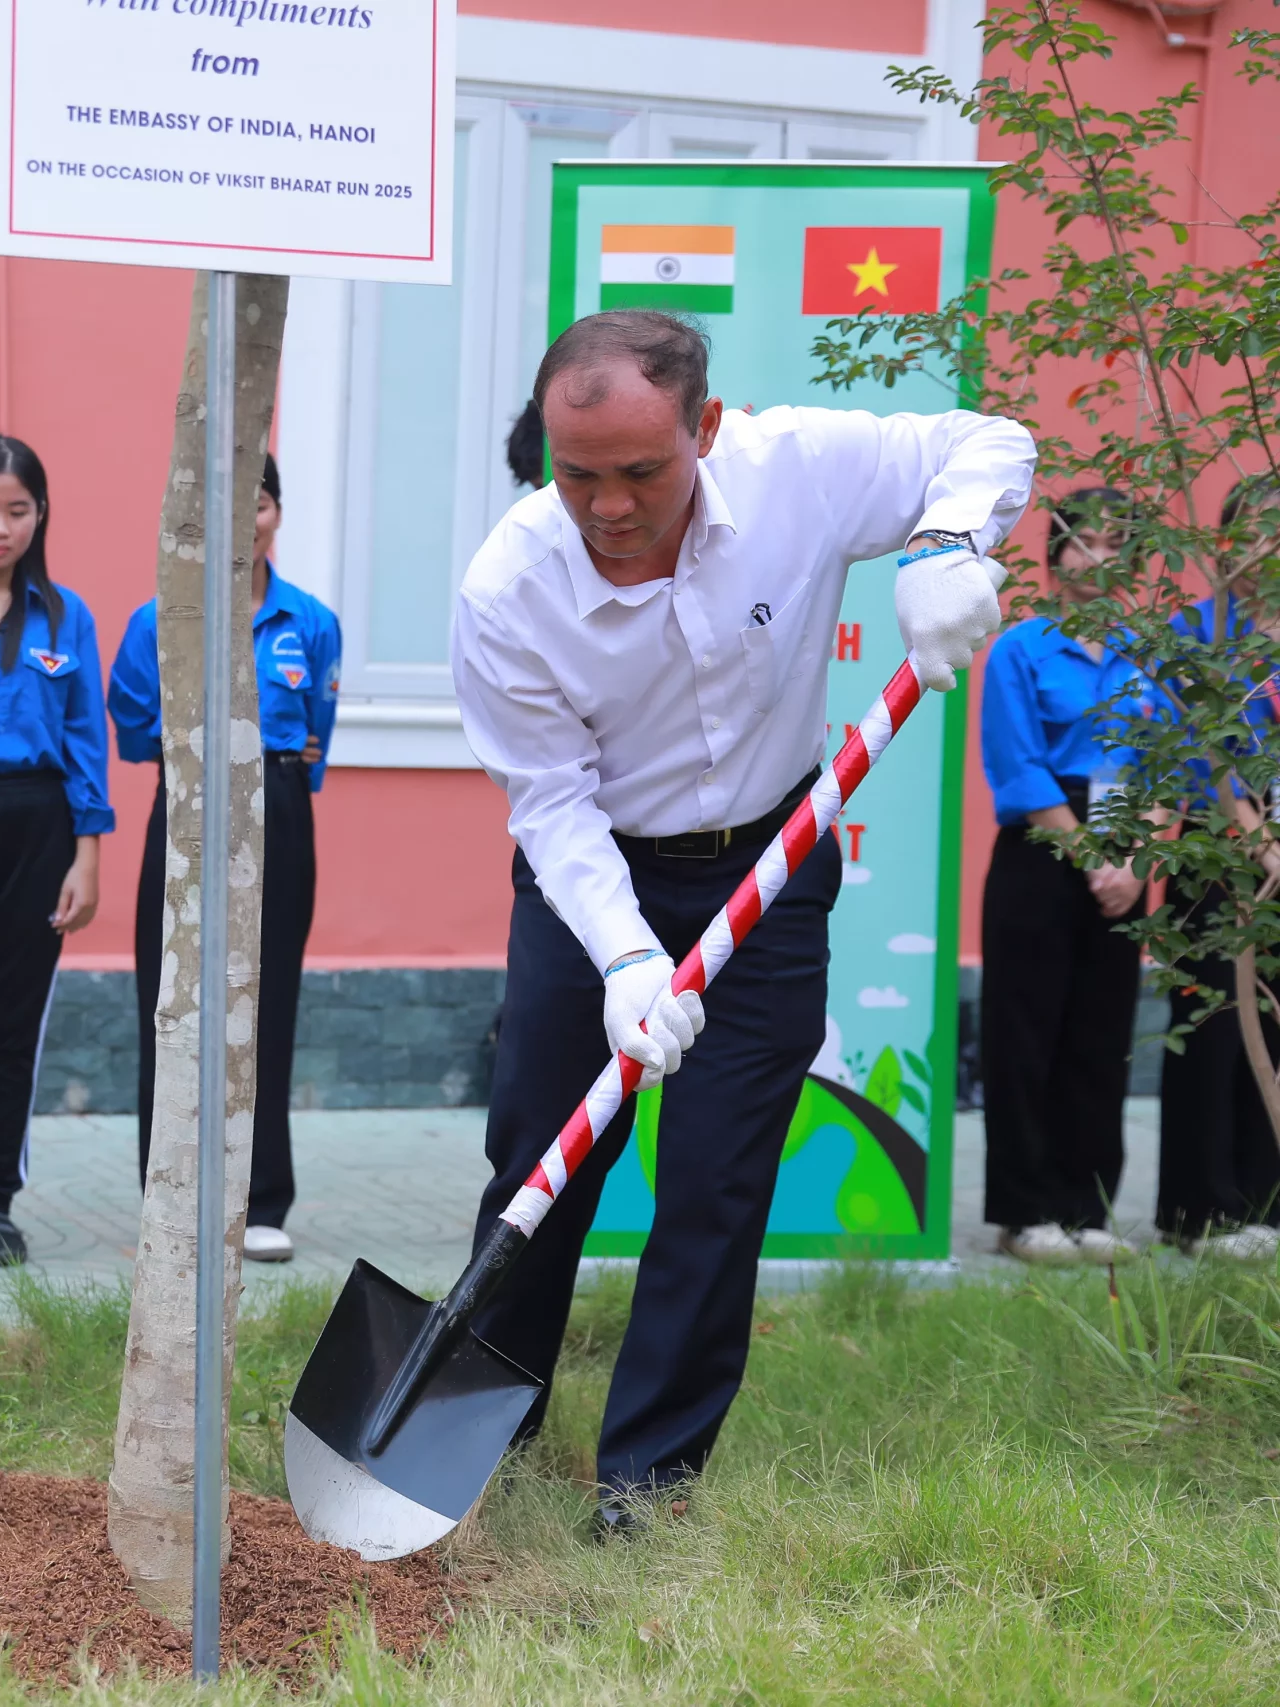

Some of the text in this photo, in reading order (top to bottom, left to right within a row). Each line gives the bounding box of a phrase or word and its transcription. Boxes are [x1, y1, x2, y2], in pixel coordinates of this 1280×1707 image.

[172, 0, 373, 28] compliments
[192, 48, 260, 76] from
[67, 105, 375, 144] THE EMBASSY OF INDIA, HANOI
[27, 160, 412, 199] ON THE OCCASION OF VIKSIT BHARAT RUN 2025
